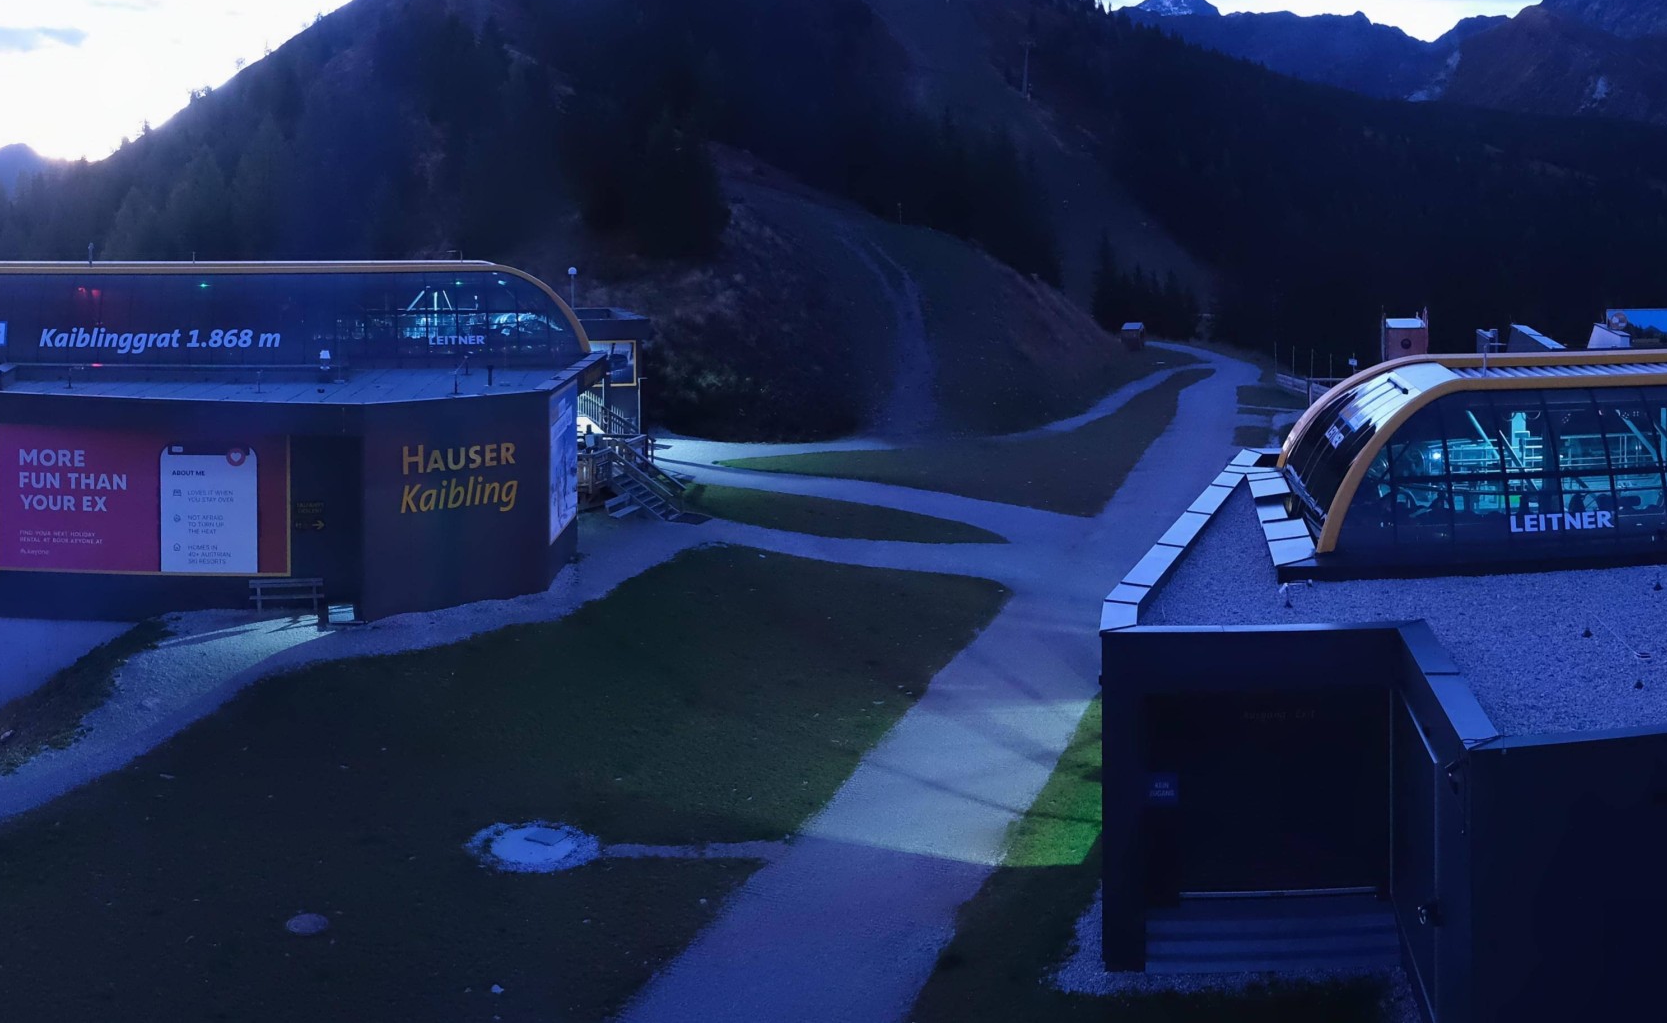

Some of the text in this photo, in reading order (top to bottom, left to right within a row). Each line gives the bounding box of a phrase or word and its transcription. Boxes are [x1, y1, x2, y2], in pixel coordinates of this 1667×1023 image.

[39, 327, 281, 354] Kaiblinggrat 1.868 m
[428, 335, 487, 345] LEITNER
[19, 448, 86, 468] MORE
[402, 442, 516, 475] HAUSER
[19, 471, 128, 491] FUN THAN
[19, 494, 107, 512] YOUR EX
[400, 476, 518, 514] Kaibling
[1509, 510, 1615, 533] LEITNER
